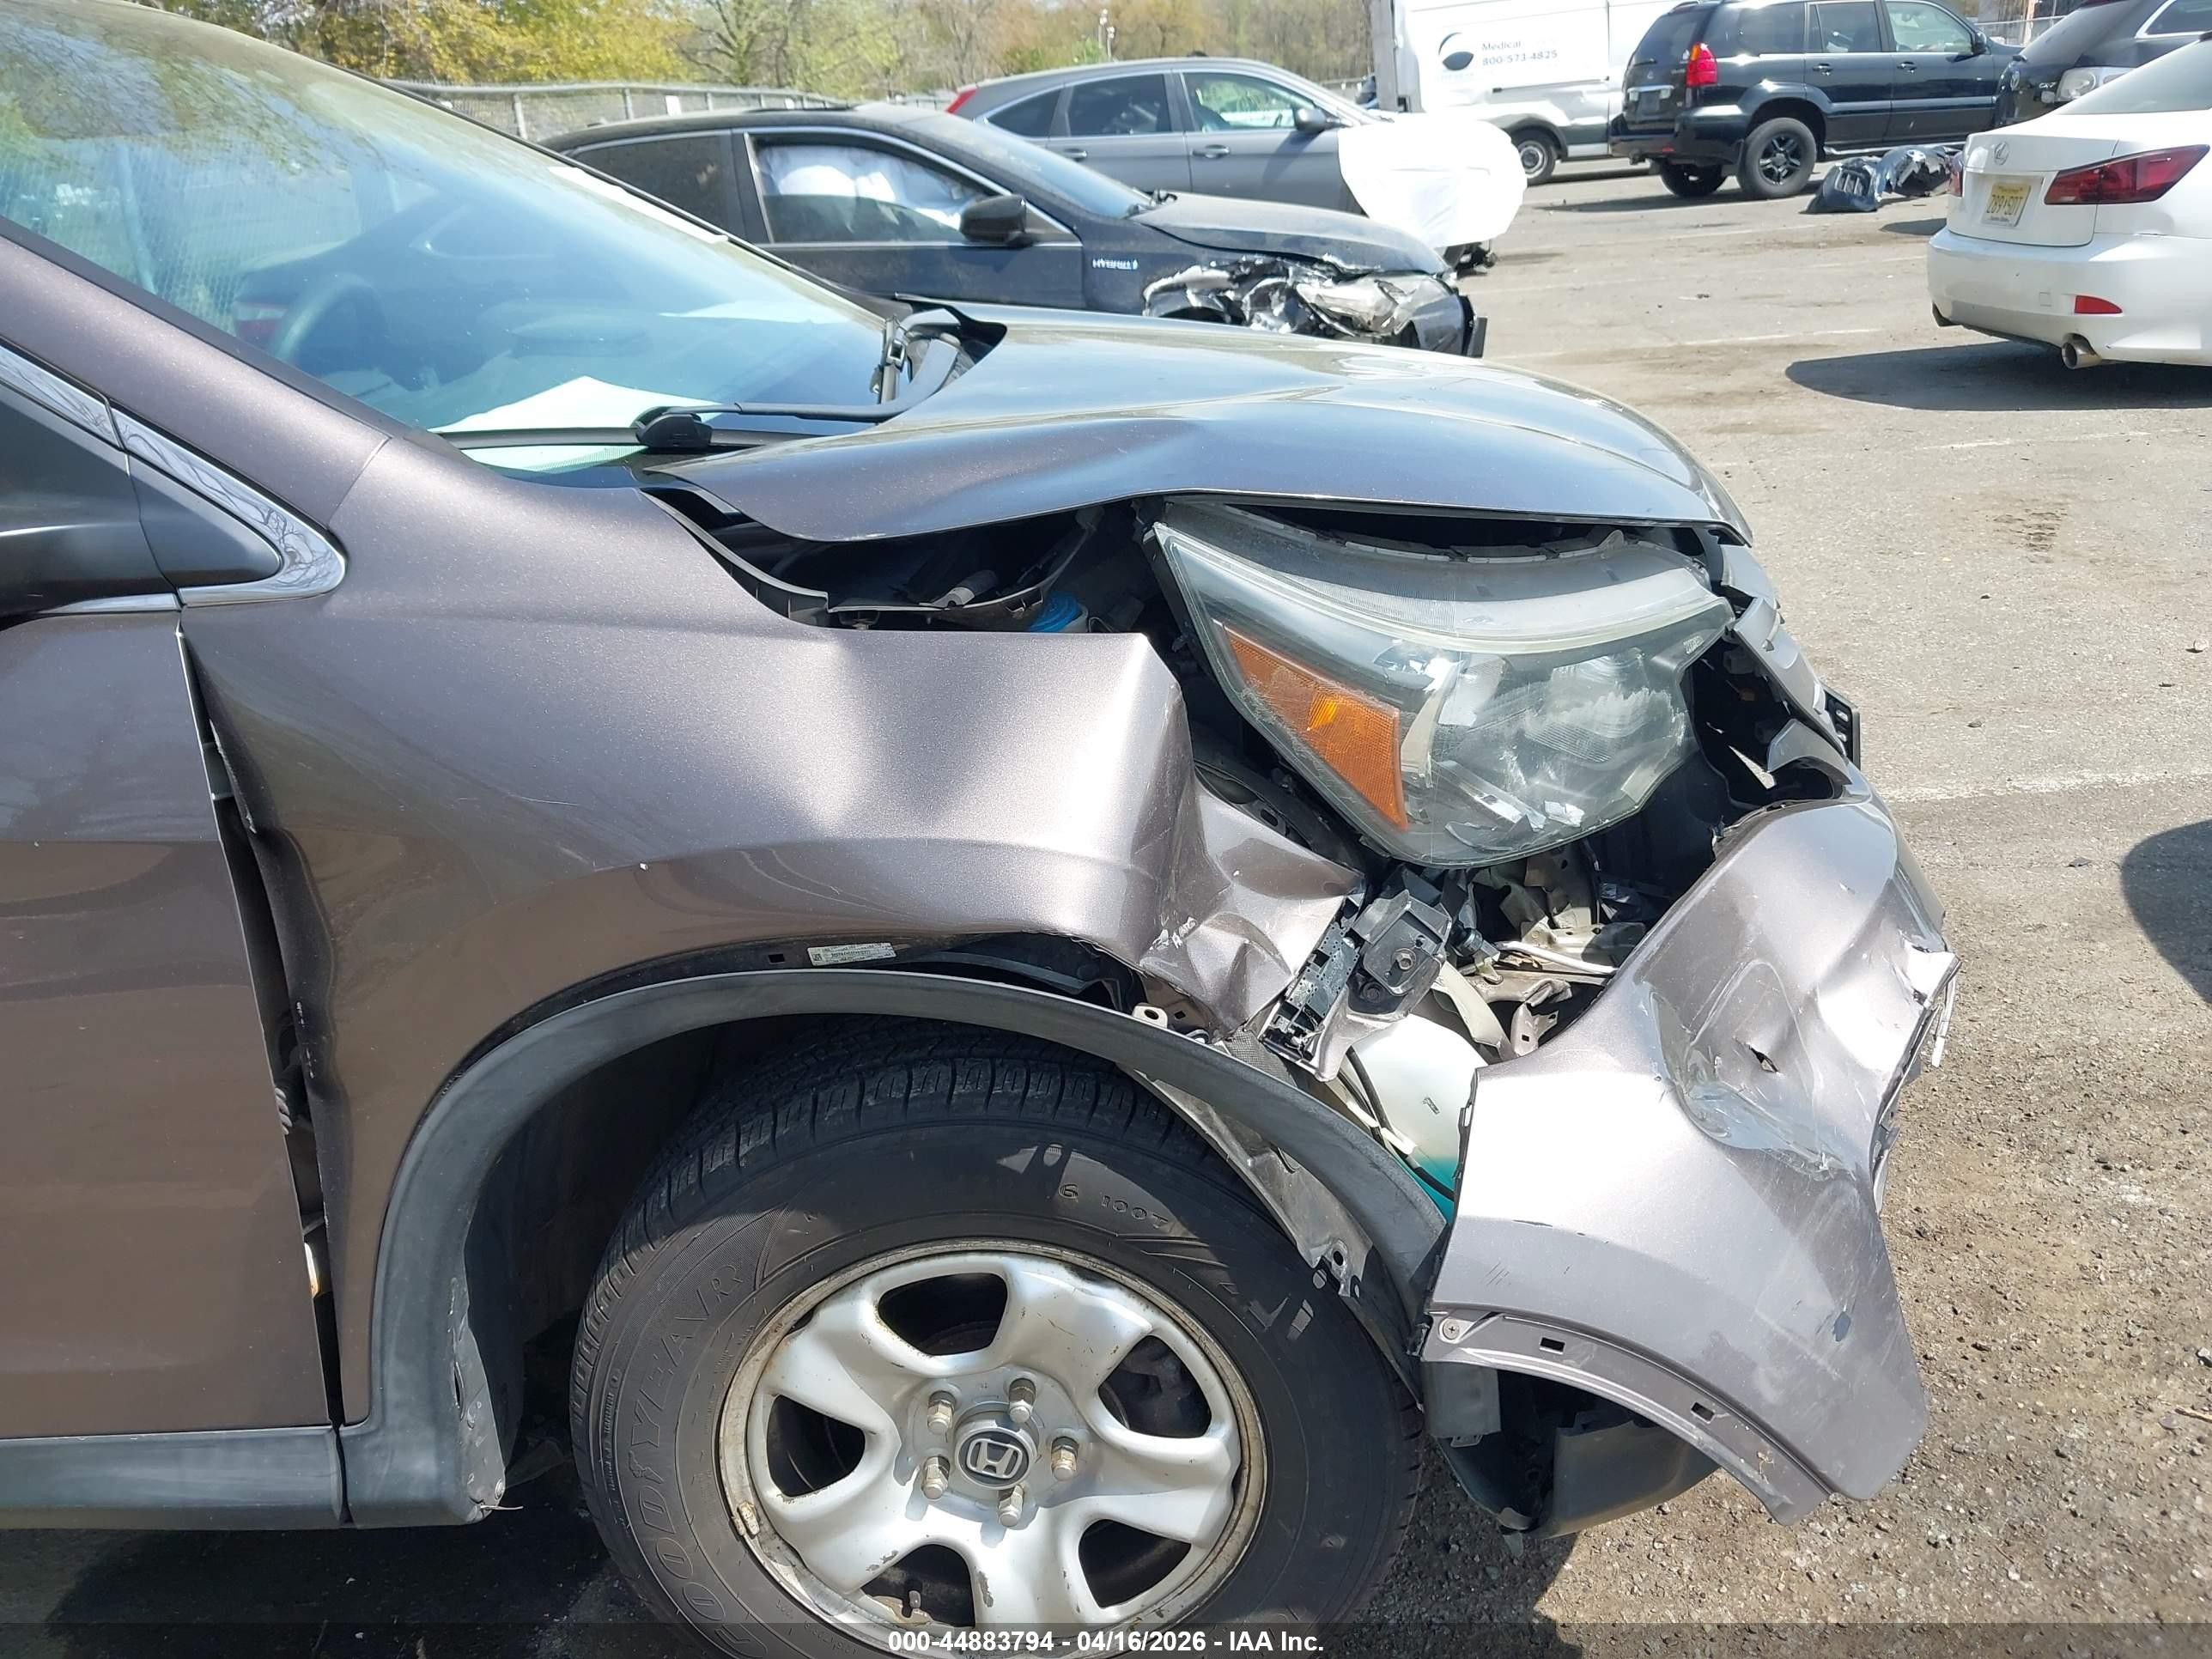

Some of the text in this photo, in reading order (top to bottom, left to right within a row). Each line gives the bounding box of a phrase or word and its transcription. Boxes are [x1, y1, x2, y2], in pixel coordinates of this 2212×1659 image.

[1481, 40, 1522, 51] Medical
[1092, 258, 1133, 270] HYBRID
[628, 1263, 769, 1658] GOODYEAR
